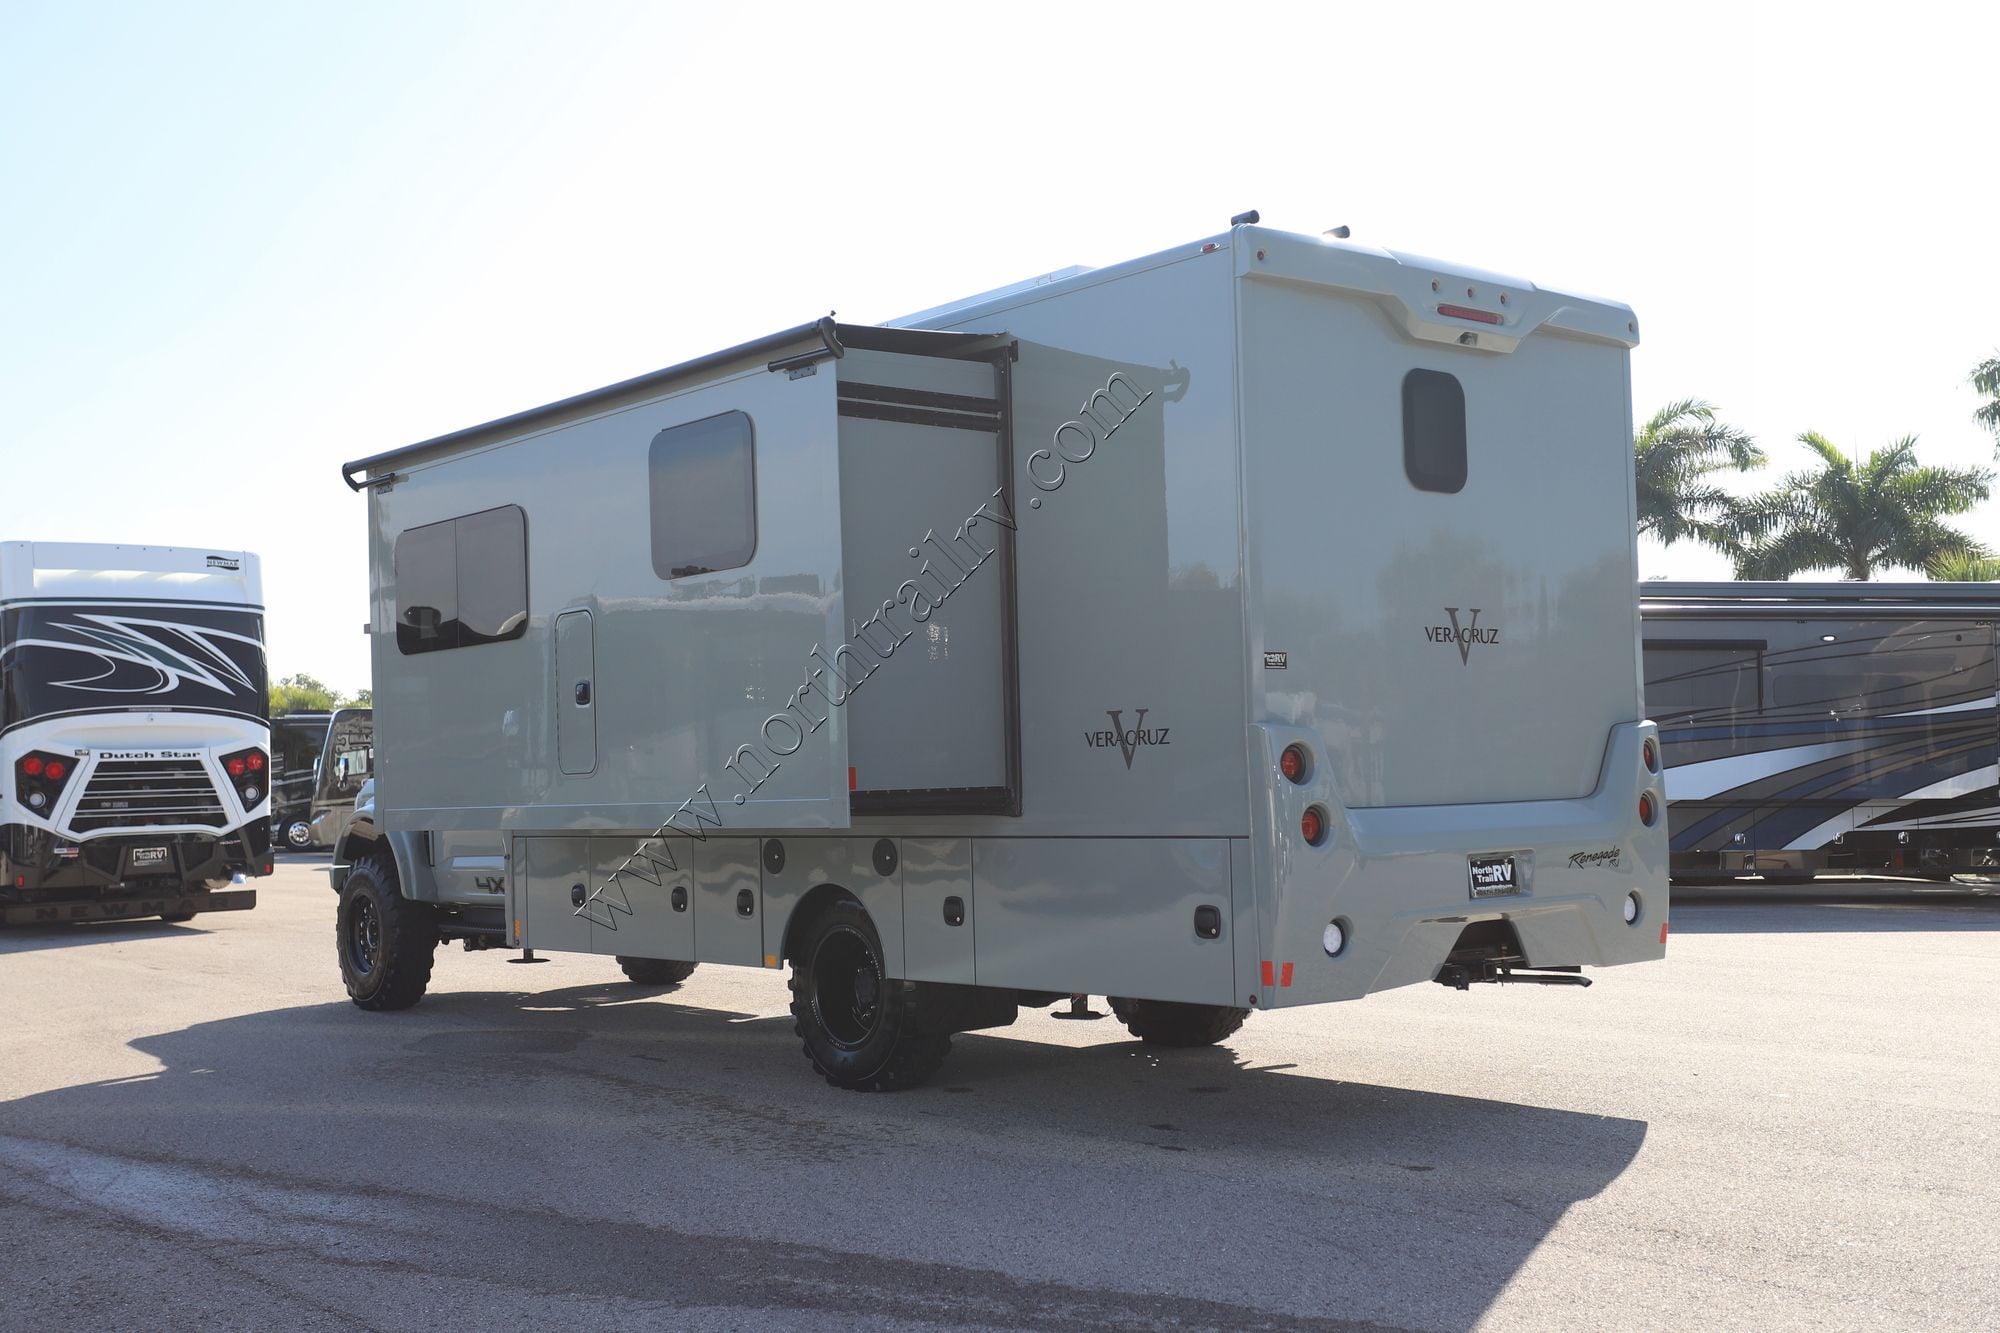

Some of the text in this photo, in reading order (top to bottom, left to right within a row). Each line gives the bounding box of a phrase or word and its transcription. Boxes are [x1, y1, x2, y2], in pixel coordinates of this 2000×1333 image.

[1424, 626, 1500, 645] VERACRUZ
[1084, 727, 1170, 748] VERACRUZ
[99, 752, 154, 760] Dutch
[1568, 845, 1621, 870] Renegade
[1472, 865, 1493, 875] North
[1476, 873, 1494, 883] Trail
[1492, 864, 1512, 882] RV
